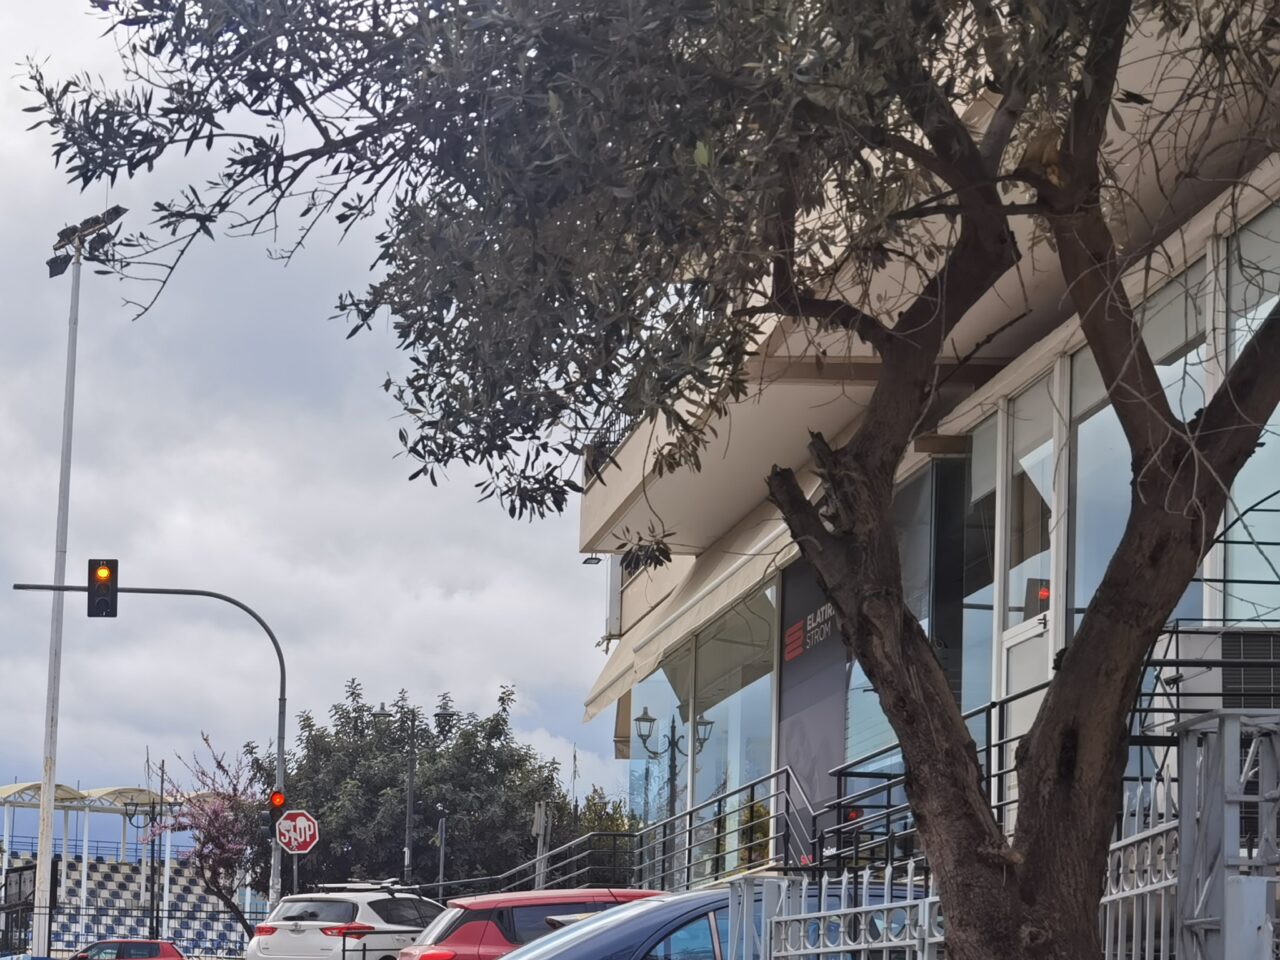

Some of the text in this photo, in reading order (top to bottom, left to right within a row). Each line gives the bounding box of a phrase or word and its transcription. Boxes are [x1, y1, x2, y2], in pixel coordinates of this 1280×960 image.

[806, 603, 835, 631] ELATIR
[806, 620, 831, 649] STROM
[280, 817, 314, 843] STOP
